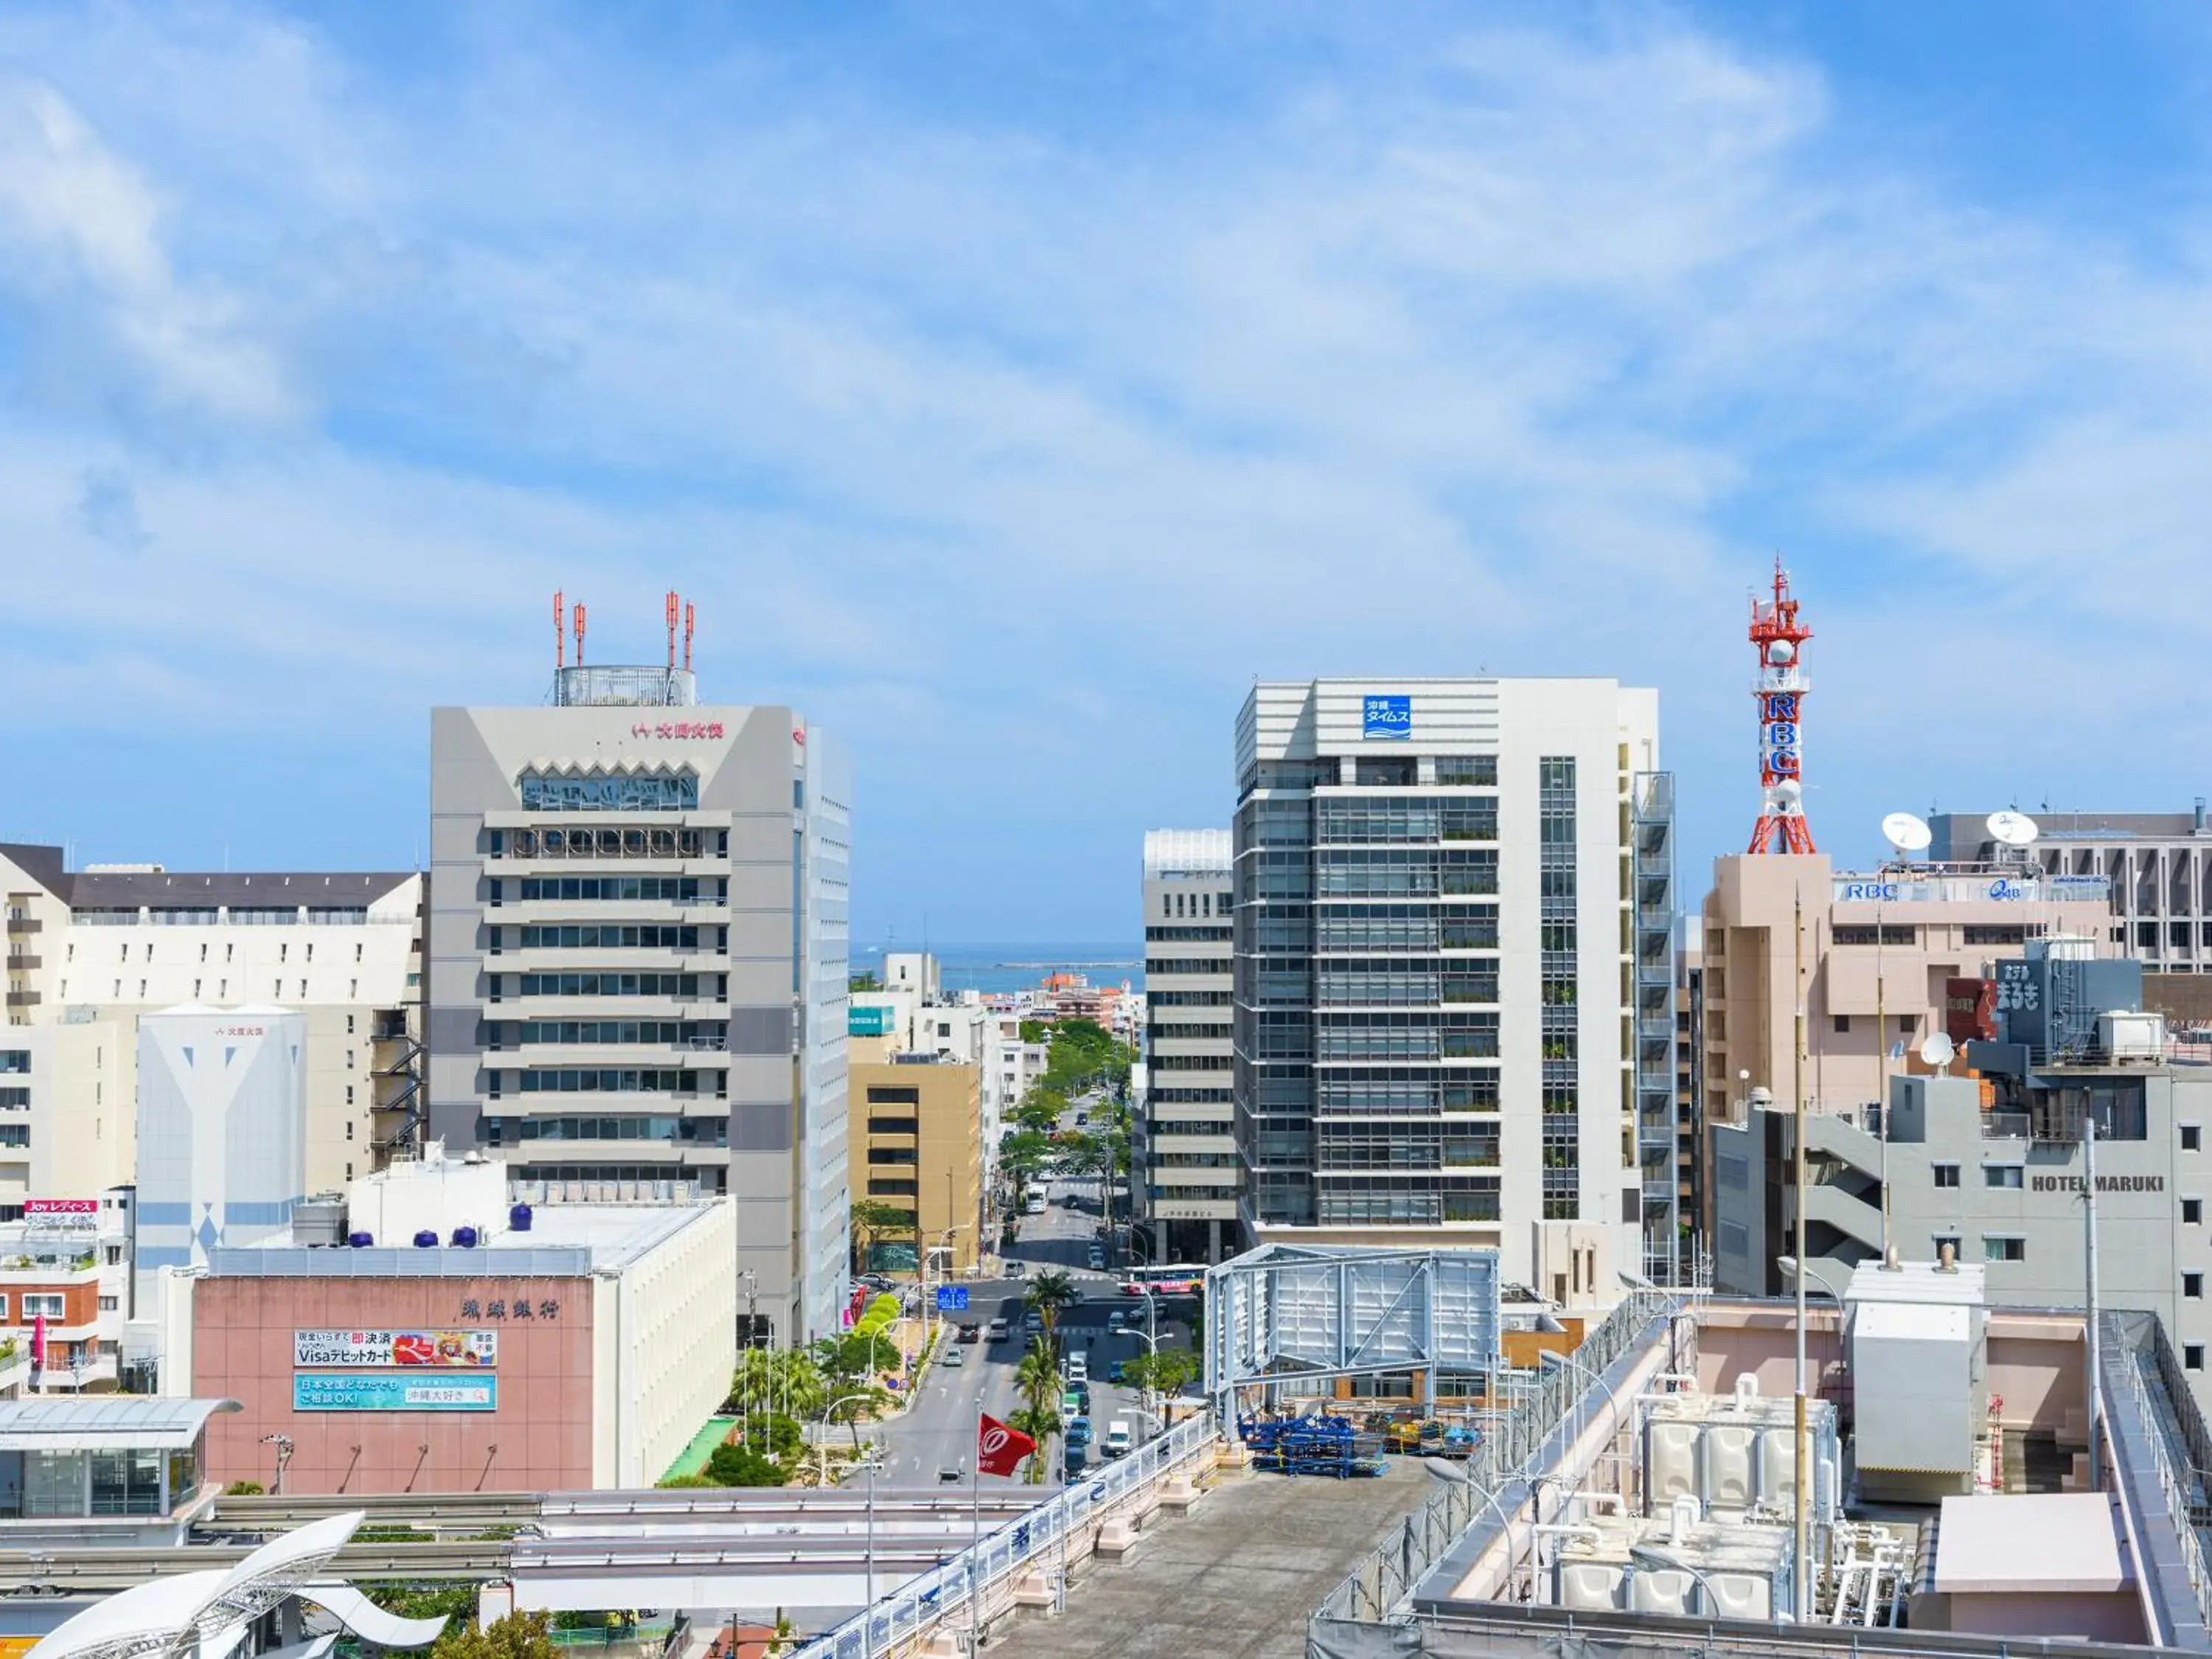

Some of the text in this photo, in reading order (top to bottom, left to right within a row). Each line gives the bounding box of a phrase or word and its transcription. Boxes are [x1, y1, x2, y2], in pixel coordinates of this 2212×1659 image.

[1367, 711, 1409, 722] タイムス
[1770, 695, 1797, 773] RBC
[1848, 884, 1898, 899] RBC
[1996, 981, 2039, 1011] まるき
[2032, 1176, 2164, 1192] HOTEL MARUKI
[29, 1201, 91, 1211] Joy レディース
[459, 1299, 560, 1321] 琉球銀行
[299, 1349, 391, 1363] Visaデビットカード
[302, 1380, 398, 1391] 日本全国どなたでも
[408, 1390, 463, 1401] 沖縄大好き
